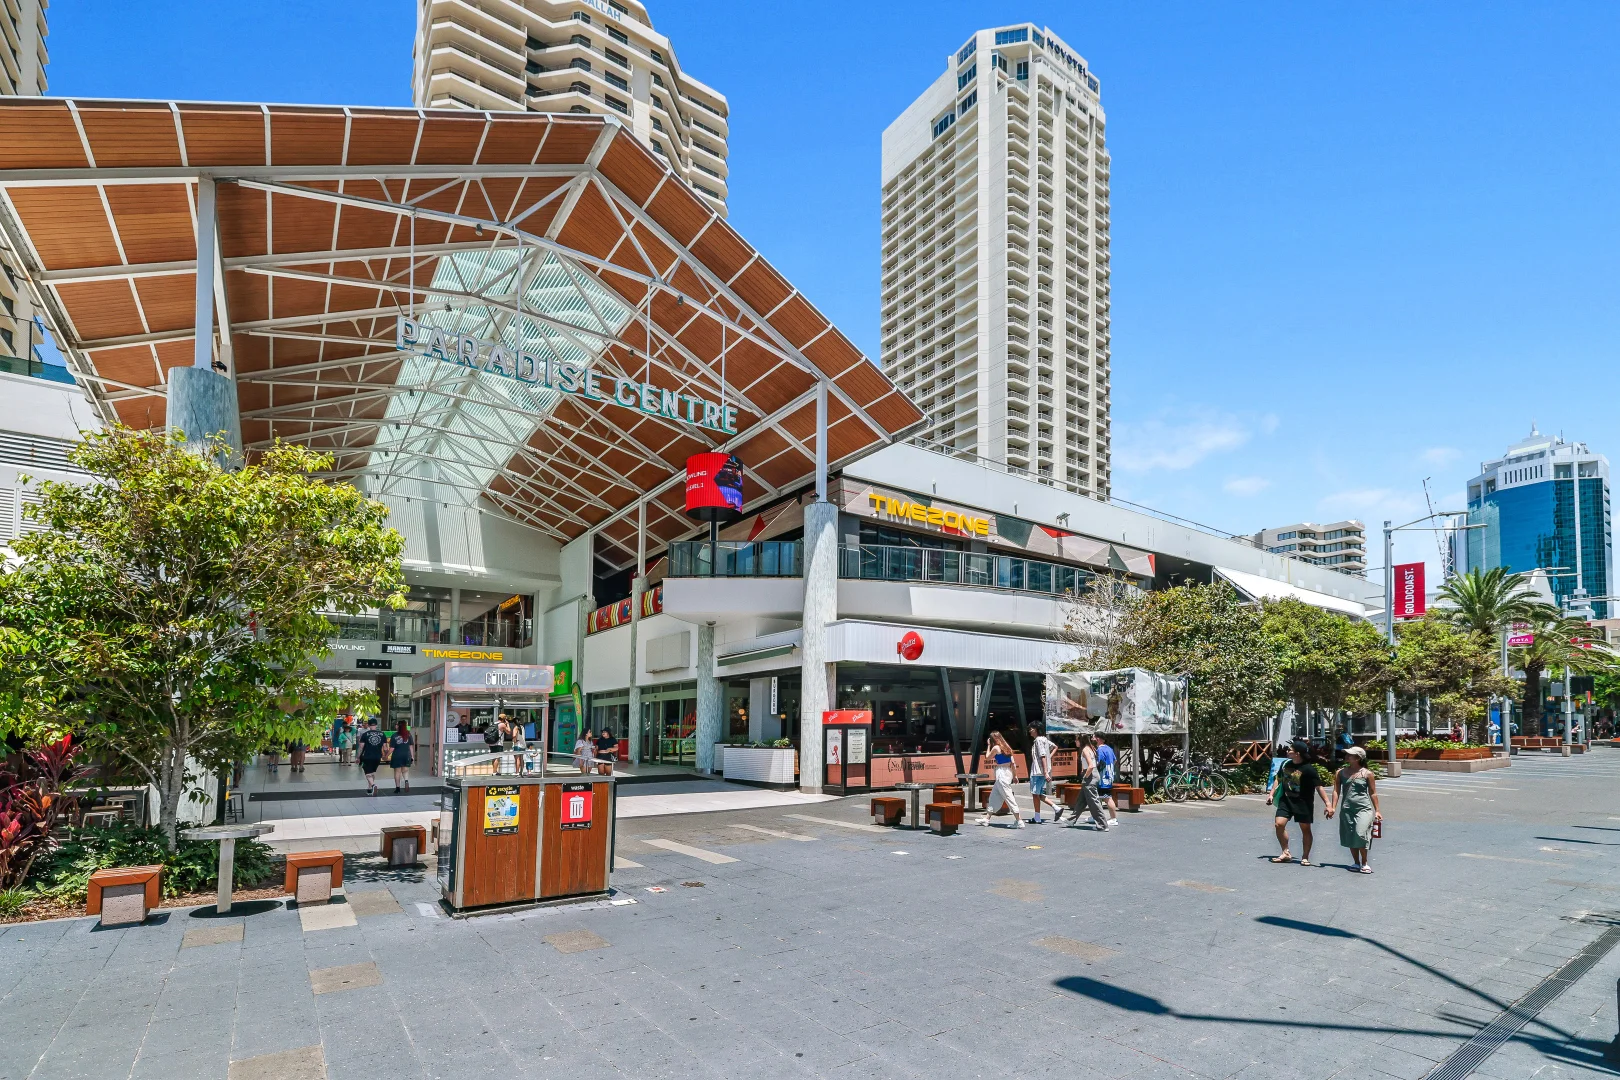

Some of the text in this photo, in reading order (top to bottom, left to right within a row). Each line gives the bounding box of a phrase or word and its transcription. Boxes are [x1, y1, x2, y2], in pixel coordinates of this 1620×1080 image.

[583, 0, 621, 22] ALLAH
[1046, 36, 1088, 78] NOVOTEL
[396, 314, 739, 435] PARADISE CENTRE
[868, 493, 989, 536] TIMEZONE
[421, 649, 503, 661] TIMEZONE
